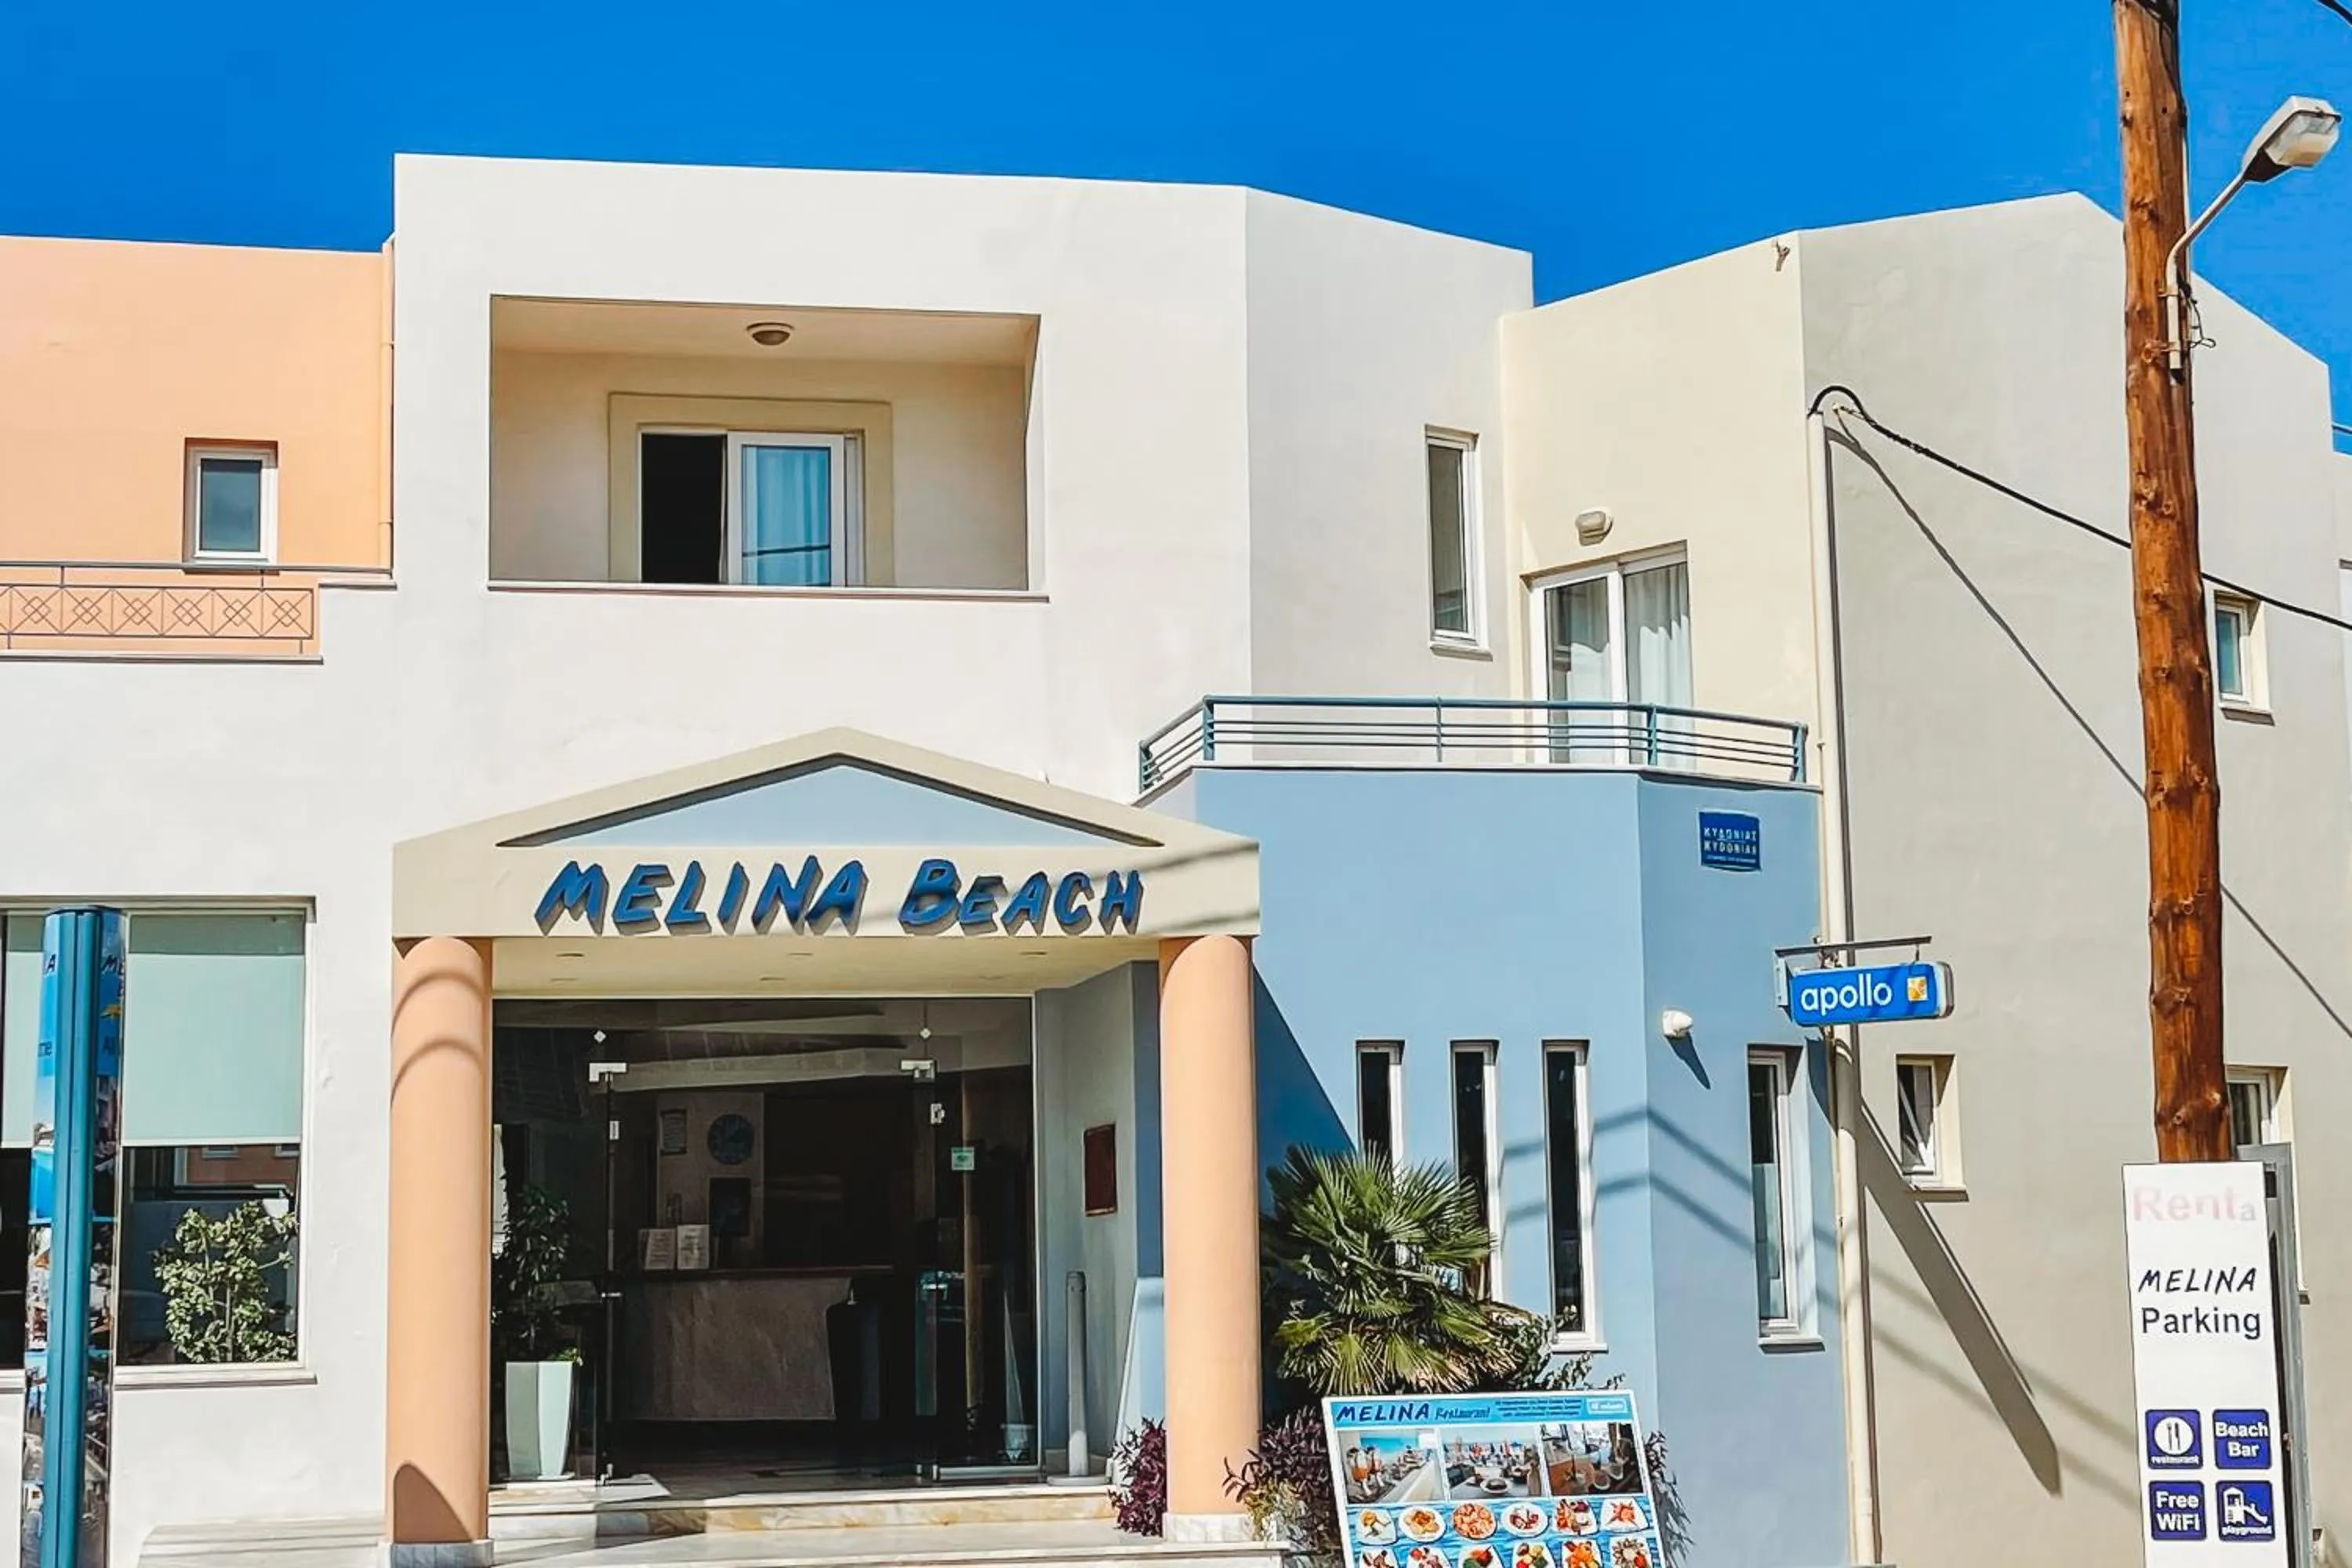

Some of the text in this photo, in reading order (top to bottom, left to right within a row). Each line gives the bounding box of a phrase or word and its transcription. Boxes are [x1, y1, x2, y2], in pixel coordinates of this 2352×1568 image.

[535, 855, 869, 936] MELINA
[1801, 973, 1893, 1016] apollo
[2138, 1266, 2256, 1295] MELINA
[2142, 1307, 2260, 1340] Parking
[1337, 1403, 1430, 1421] MELINA
[2215, 1422, 2269, 1437] Beach
[2227, 1442, 2259, 1457] Bar
[2156, 1491, 2199, 1508] Free
[2157, 1513, 2201, 1531] WiFi
